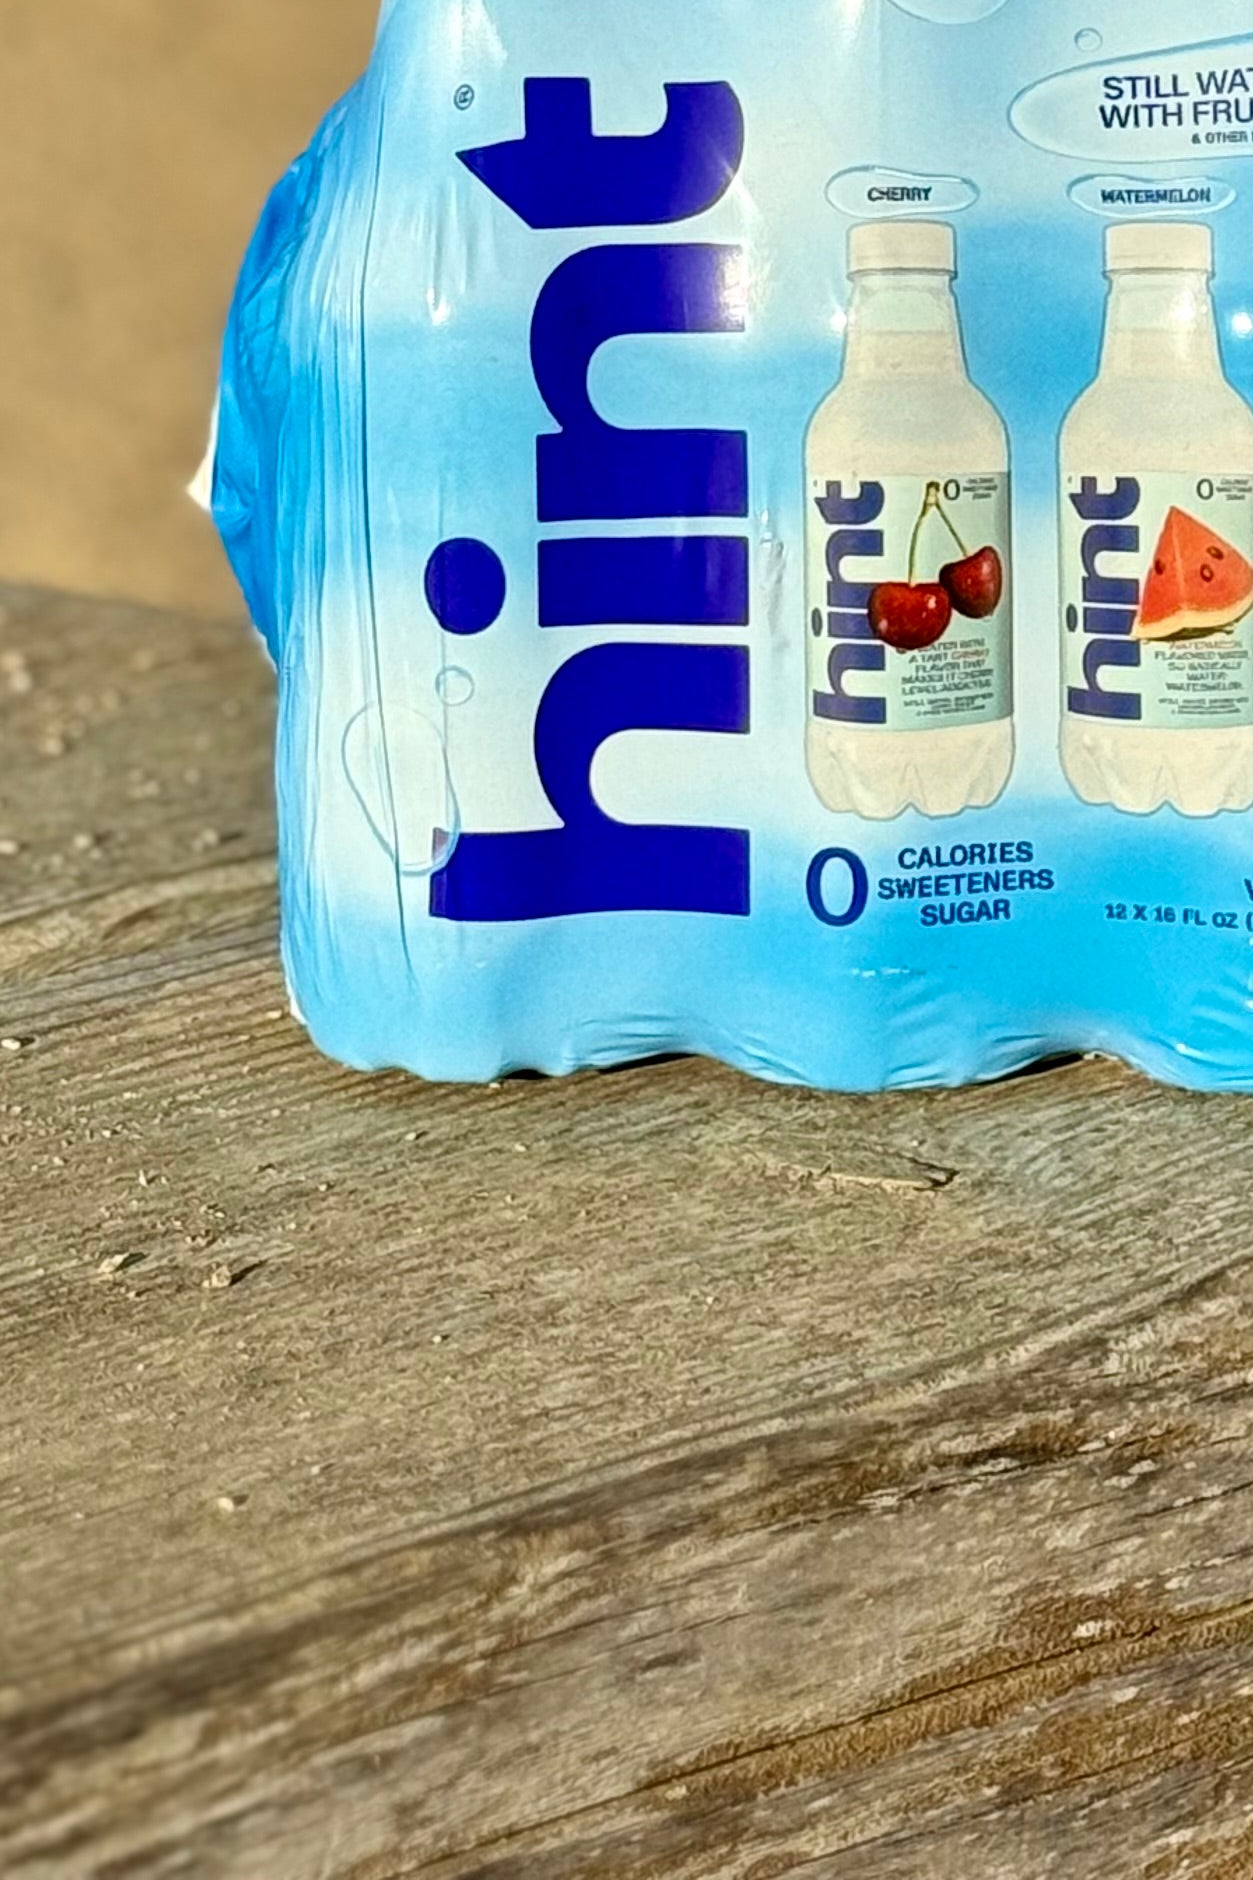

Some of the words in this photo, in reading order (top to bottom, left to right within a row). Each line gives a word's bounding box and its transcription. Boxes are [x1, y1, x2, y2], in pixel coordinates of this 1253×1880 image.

[1103, 75, 1190, 100] STILL
[1100, 103, 1183, 129] WITH
[1205, 131, 1249, 144] OTHER
[867, 187, 933, 203] CHERRY
[1100, 187, 1212, 204] WATERMELON
[424, 76, 750, 921] hint
[812, 480, 887, 725] hint
[1066, 476, 1142, 720] hint
[898, 841, 1033, 870] CALORIES
[806, 847, 868, 927] 0
[877, 869, 1054, 900] SWEETENERS
[920, 899, 1011, 927] SUGAR
[1104, 903, 1128, 920] 12
[1132, 903, 1148, 921] X
[1154, 905, 1177, 923] 16
[1183, 907, 1207, 926] FL
[1212, 912, 1240, 929] OZ
